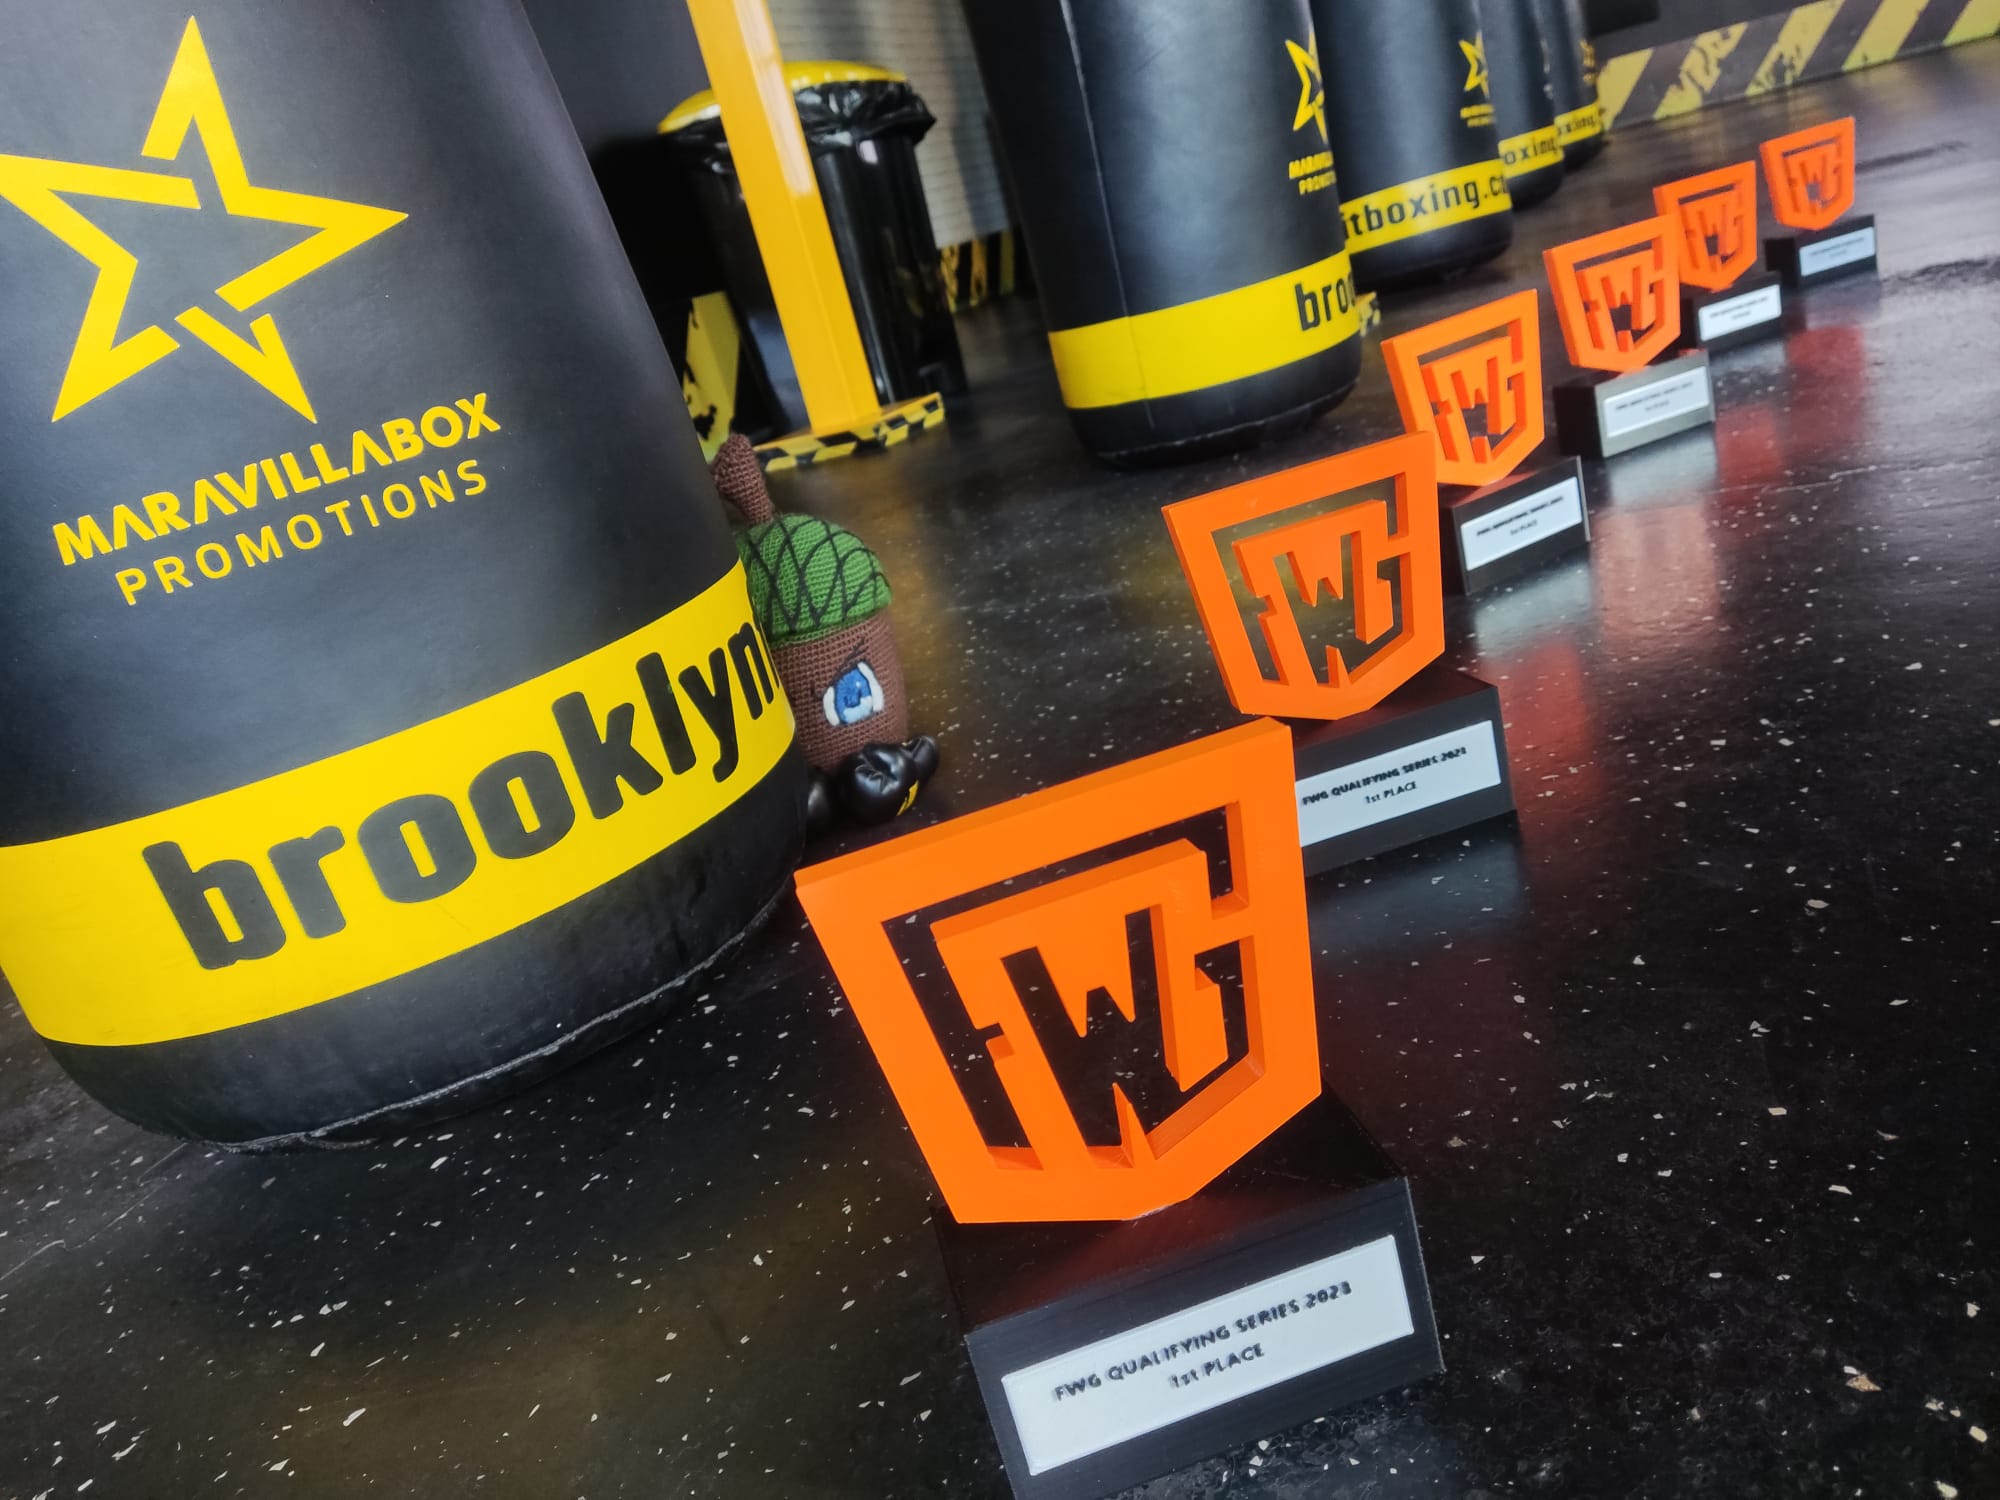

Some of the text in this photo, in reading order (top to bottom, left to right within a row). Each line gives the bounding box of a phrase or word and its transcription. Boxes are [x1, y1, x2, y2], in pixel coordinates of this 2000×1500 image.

[52, 392, 501, 566] MARAVILLABOX
[115, 459, 487, 606] PROMOTIONS
[142, 620, 780, 971] brooklyn
[1331, 768, 1400, 796] QUALIFYING
[1384, 781, 1417, 798] PLACE
[1053, 1280, 1352, 1402] FWG QUALIFYING SERIES 2023
[1169, 1341, 1265, 1389] 1st PLACE
